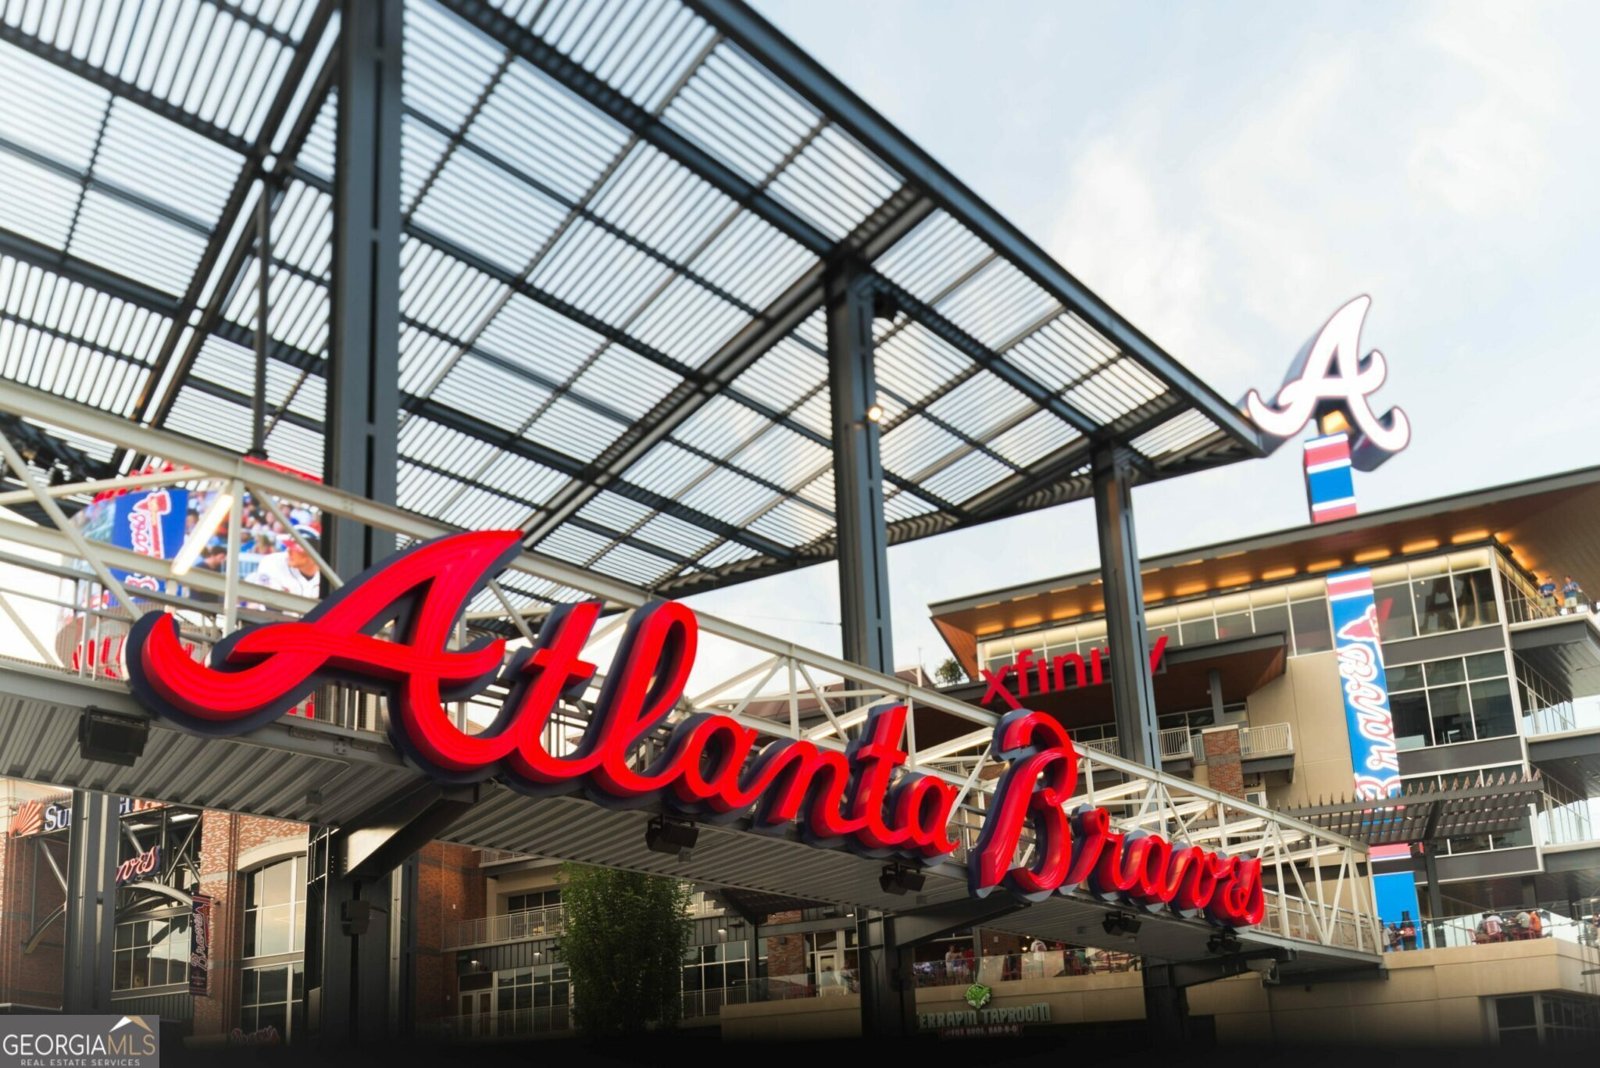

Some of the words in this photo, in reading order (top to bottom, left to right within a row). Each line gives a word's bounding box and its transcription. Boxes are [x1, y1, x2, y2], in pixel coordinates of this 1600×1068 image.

[135, 529, 959, 857] Atlanta
[971, 709, 1266, 927] Braves
[980, 634, 1168, 709] xfini
